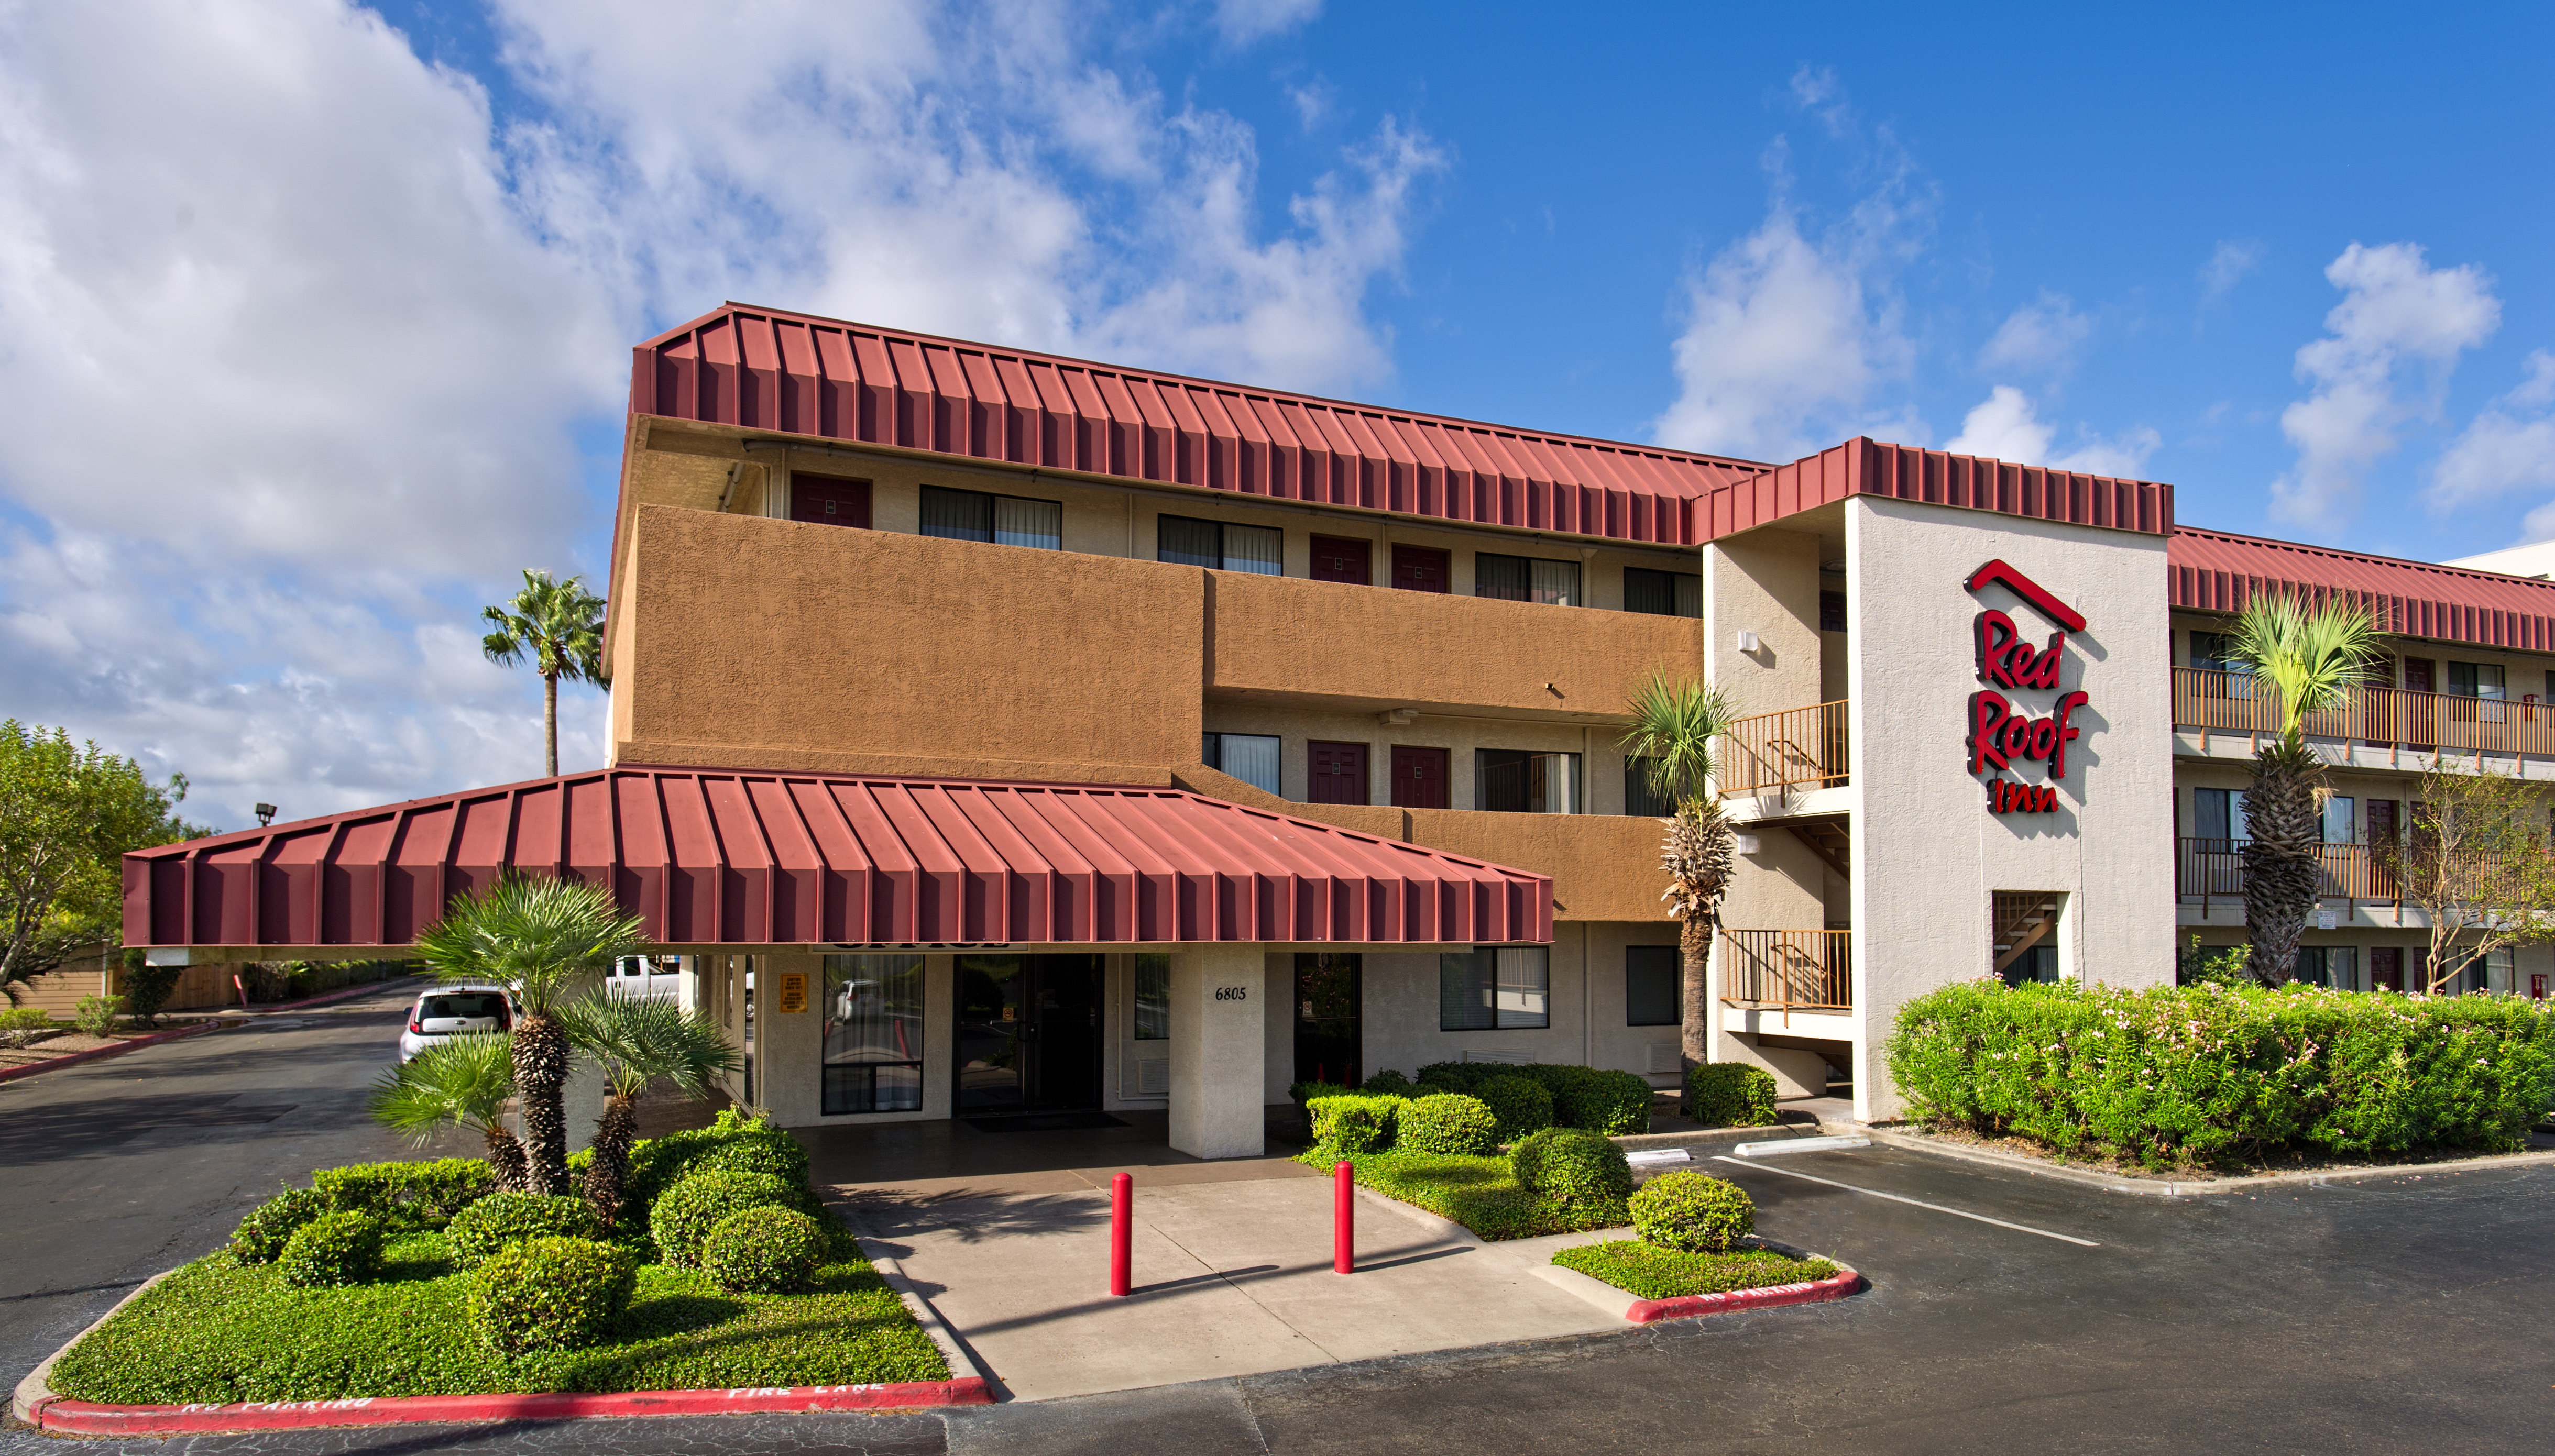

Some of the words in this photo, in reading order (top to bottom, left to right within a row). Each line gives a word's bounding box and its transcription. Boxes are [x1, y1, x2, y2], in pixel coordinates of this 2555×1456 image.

[1976, 609, 2065, 689] Red
[1967, 690, 2089, 779] Roof
[1215, 987, 1246, 1000] 6805
[1697, 1293, 1726, 1301] NO
[1731, 1282, 1814, 1298] PARKING
[728, 1386, 794, 1398] FIRE
[815, 1383, 885, 1393] LANE
[181, 1403, 220, 1413] NO
